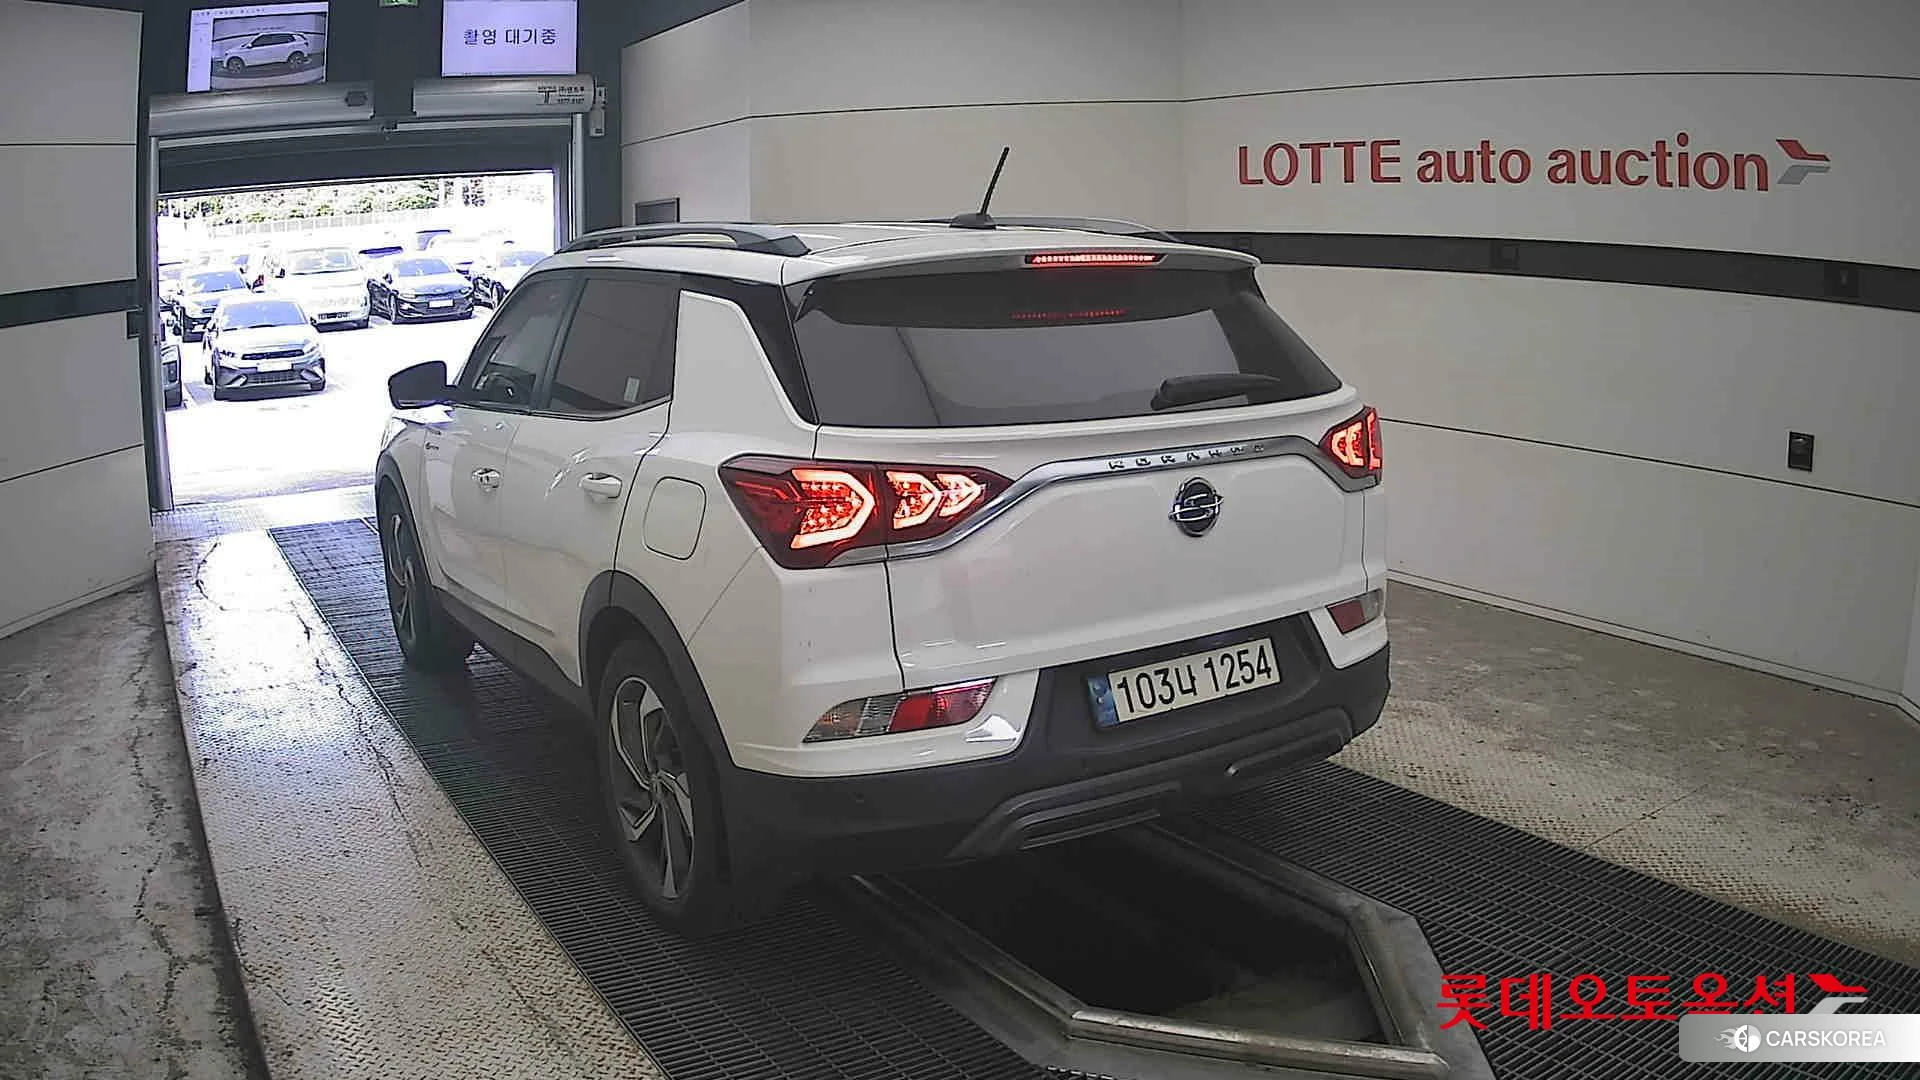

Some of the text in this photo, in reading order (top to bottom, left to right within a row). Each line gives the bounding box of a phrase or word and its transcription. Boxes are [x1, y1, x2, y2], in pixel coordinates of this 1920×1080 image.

[463, 28, 558, 45] 촬영 대기중
[1239, 132, 1769, 192] LOTTE auto auction
[1116, 644, 1272, 714] 103나 1254
